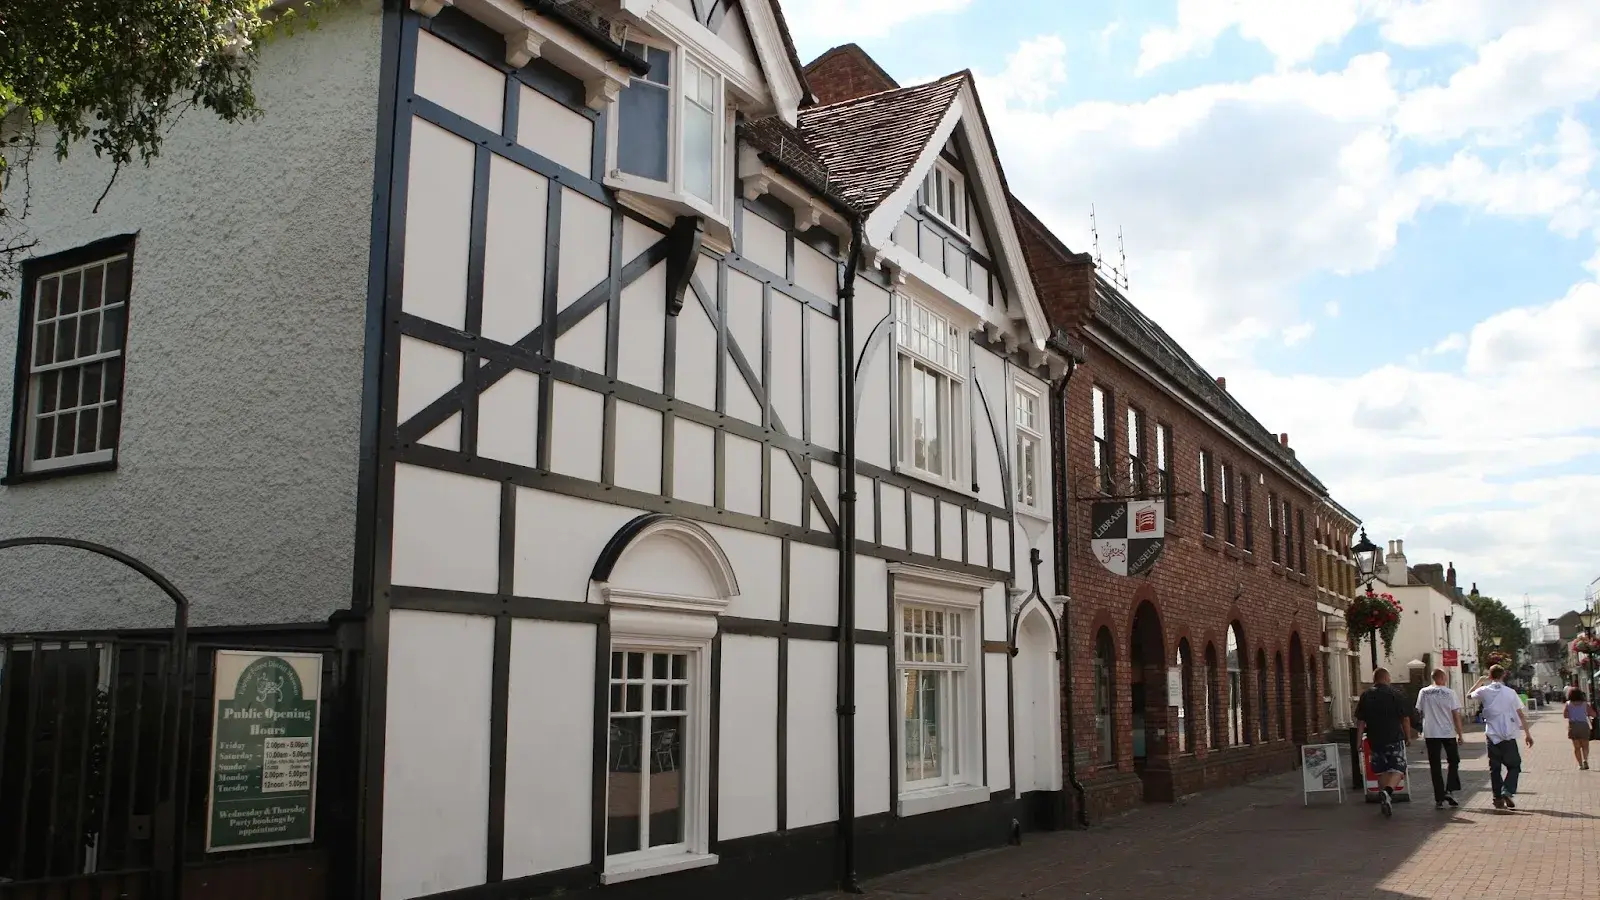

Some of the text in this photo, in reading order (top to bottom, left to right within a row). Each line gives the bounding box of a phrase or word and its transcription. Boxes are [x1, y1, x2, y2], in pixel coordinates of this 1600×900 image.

[1094, 505, 1126, 538] LIBRARY
[1129, 541, 1161, 574] MUSEUM
[223, 707, 311, 721] Public Opening
[250, 724, 286, 735] Hours
[219, 741, 246, 750] Friday
[219, 752, 253, 760] Saturday
[218, 763, 247, 771] Sunday
[218, 774, 249, 782] Monday
[217, 784, 248, 792] Tuesday
[219, 805, 306, 818] Wednesday & Thursday
[229, 814, 296, 828] Party bookings by
[238, 825, 286, 836] appointment
